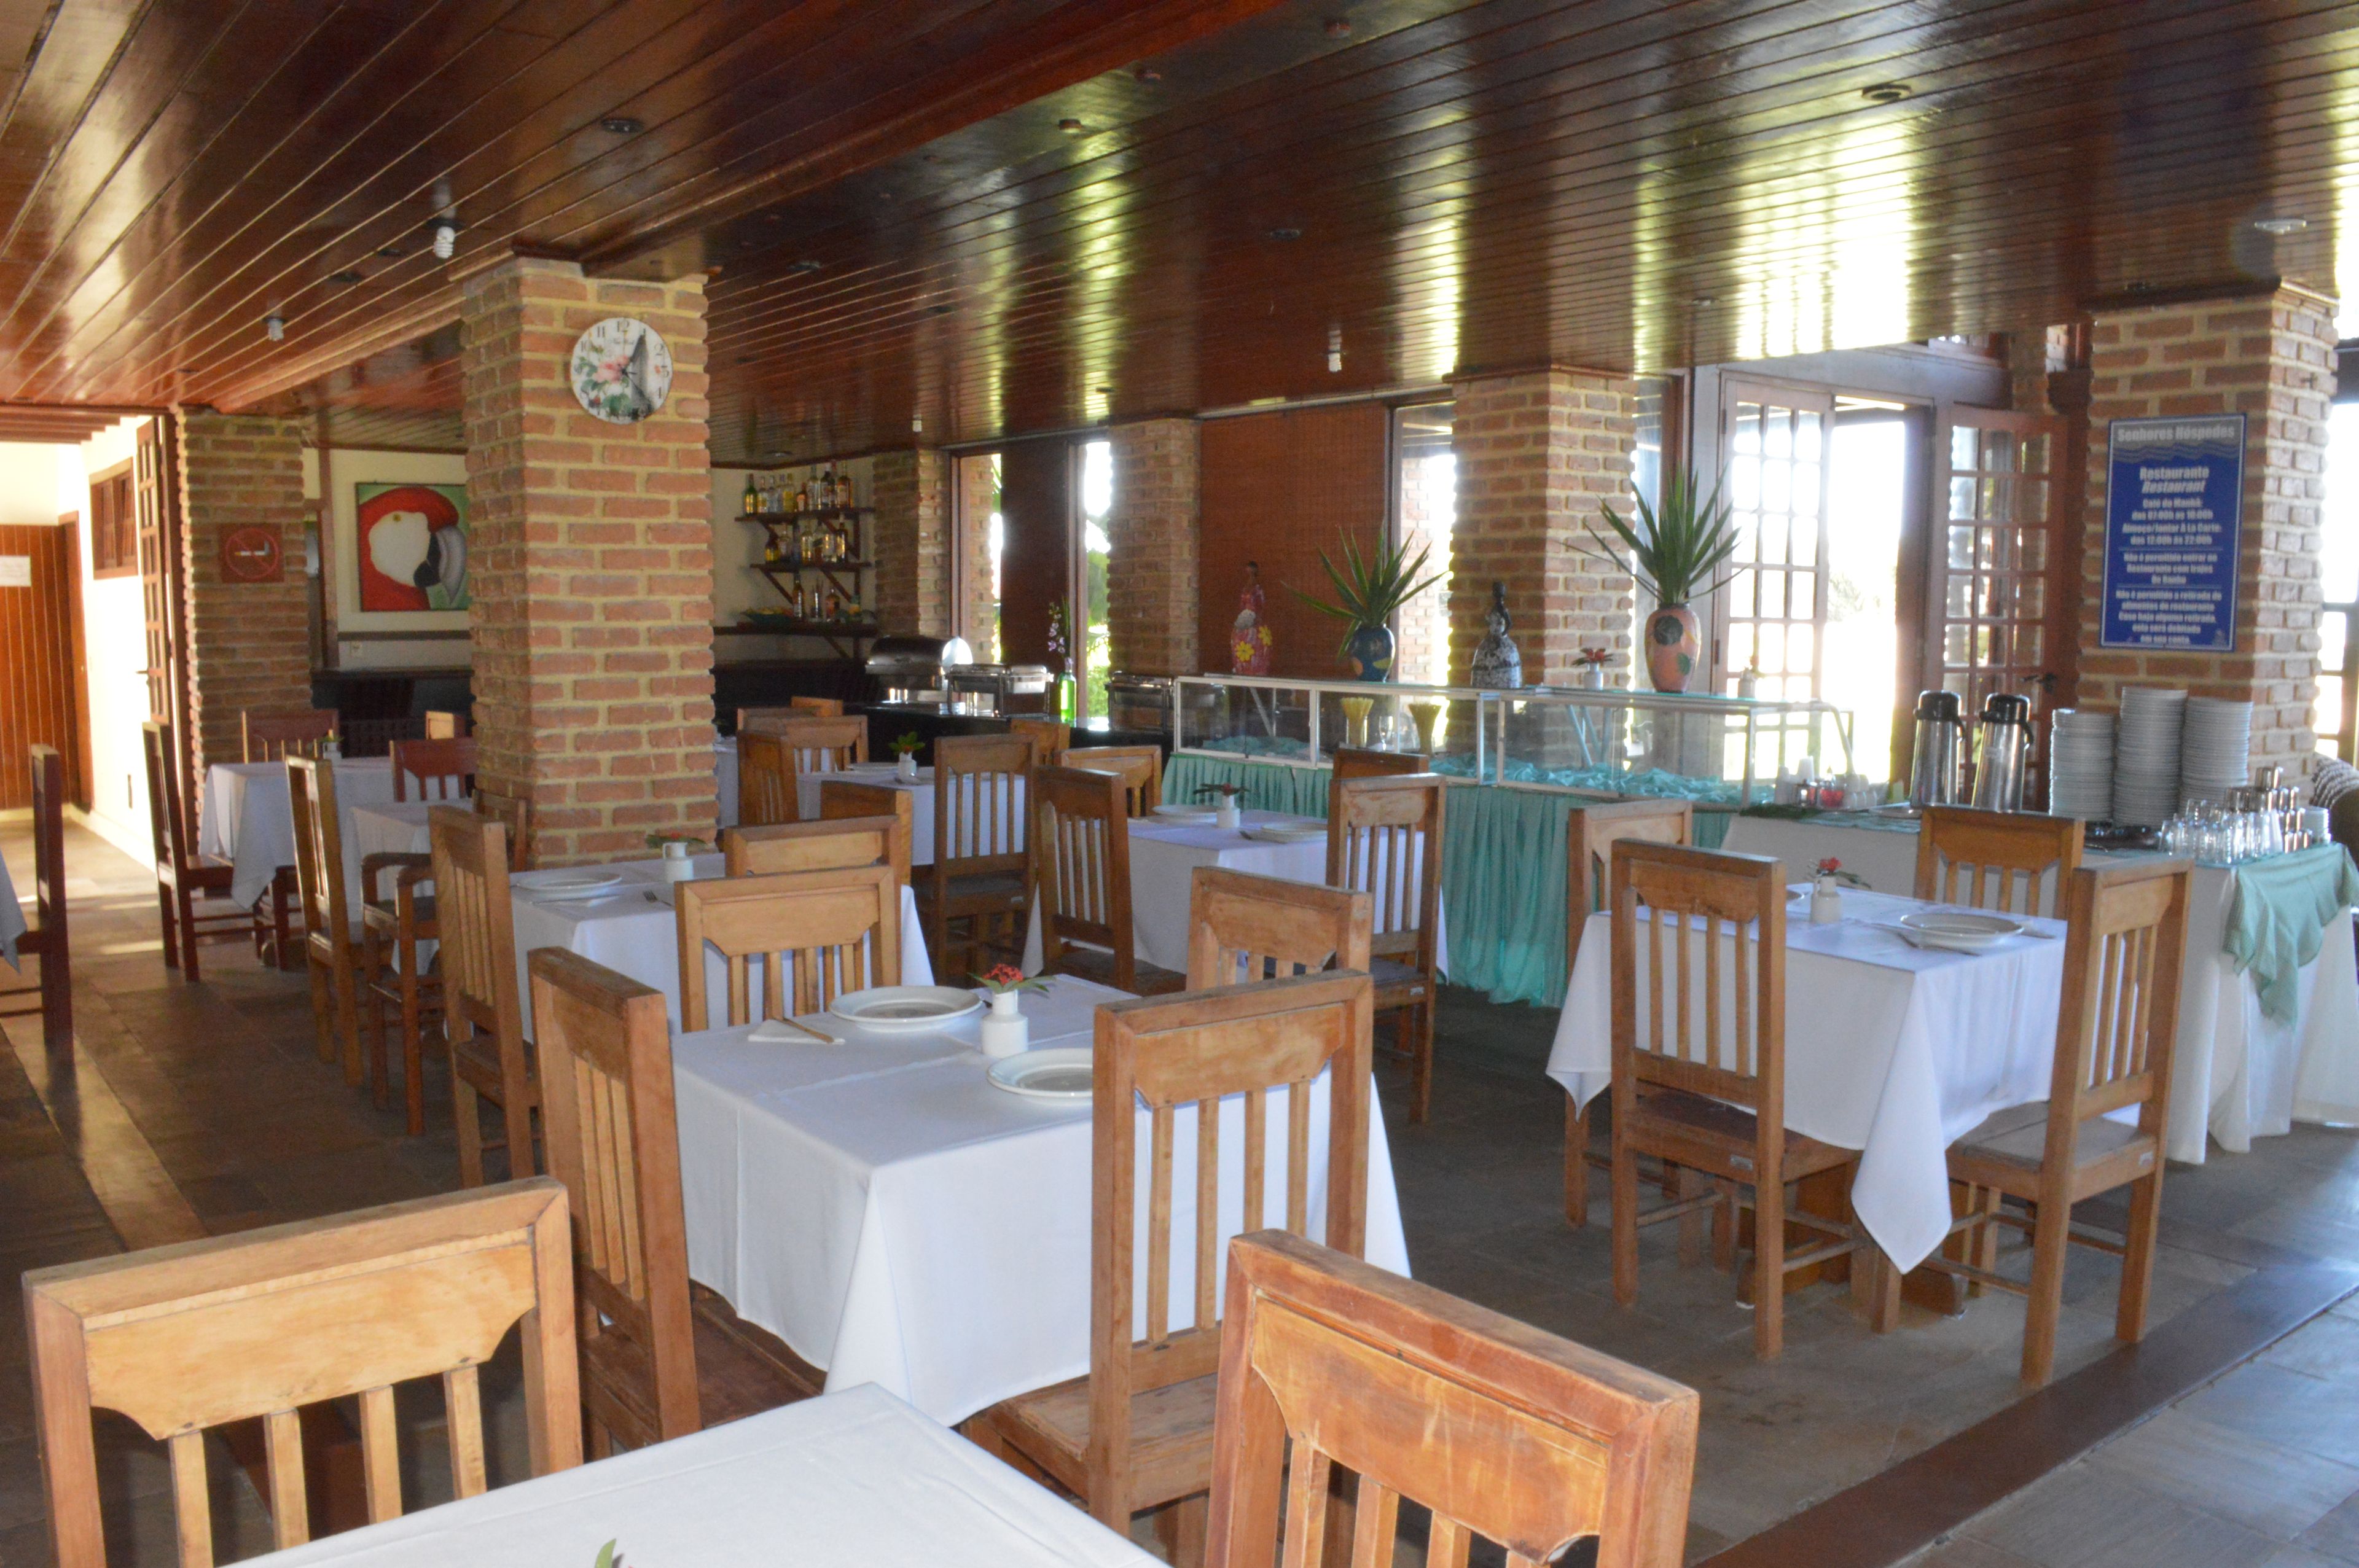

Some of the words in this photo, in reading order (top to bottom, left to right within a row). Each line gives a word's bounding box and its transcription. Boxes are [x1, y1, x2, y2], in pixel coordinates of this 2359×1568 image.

[597, 326, 605, 337] 11
[617, 321, 629, 332] 12
[654, 343, 663, 356] 2
[2118, 428, 2173, 442] Senhores
[2176, 425, 2234, 440] Hóspedes
[2140, 467, 2209, 480] Restaurante
[2142, 480, 2206, 494] Restaurant
